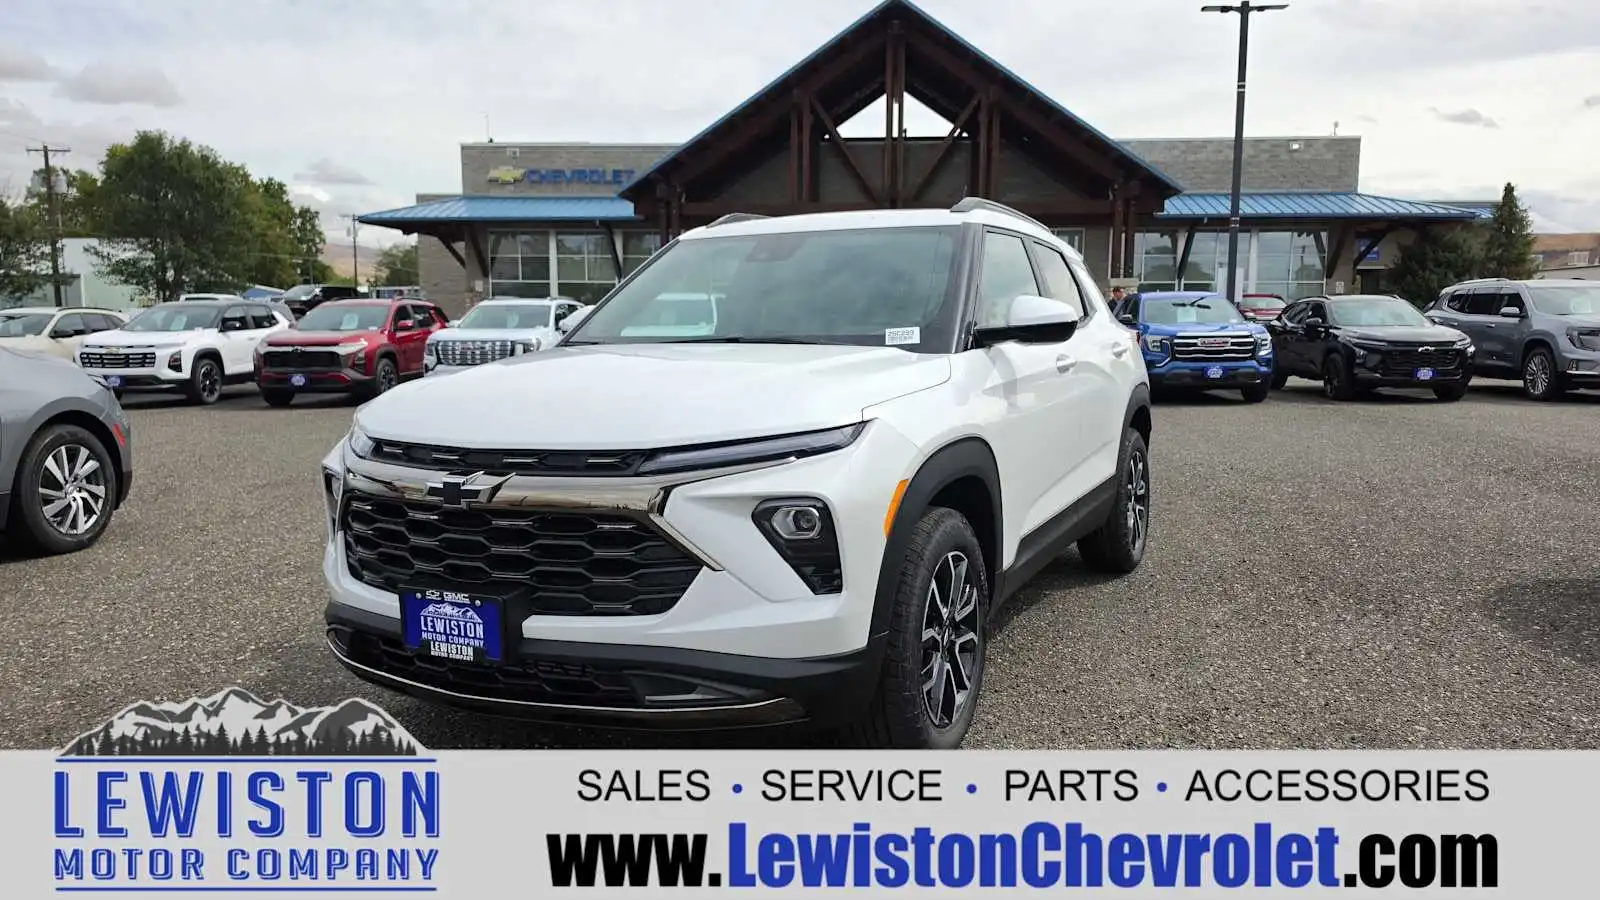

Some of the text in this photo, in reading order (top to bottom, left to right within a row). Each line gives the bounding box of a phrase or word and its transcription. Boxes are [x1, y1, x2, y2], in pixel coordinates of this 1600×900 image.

[527, 169, 636, 184] CHEVROLET
[443, 591, 470, 602] GMC
[420, 615, 484, 639] LEWISTON
[421, 631, 484, 648] MOTOR COMPANY
[430, 641, 474, 655] LEWISTON
